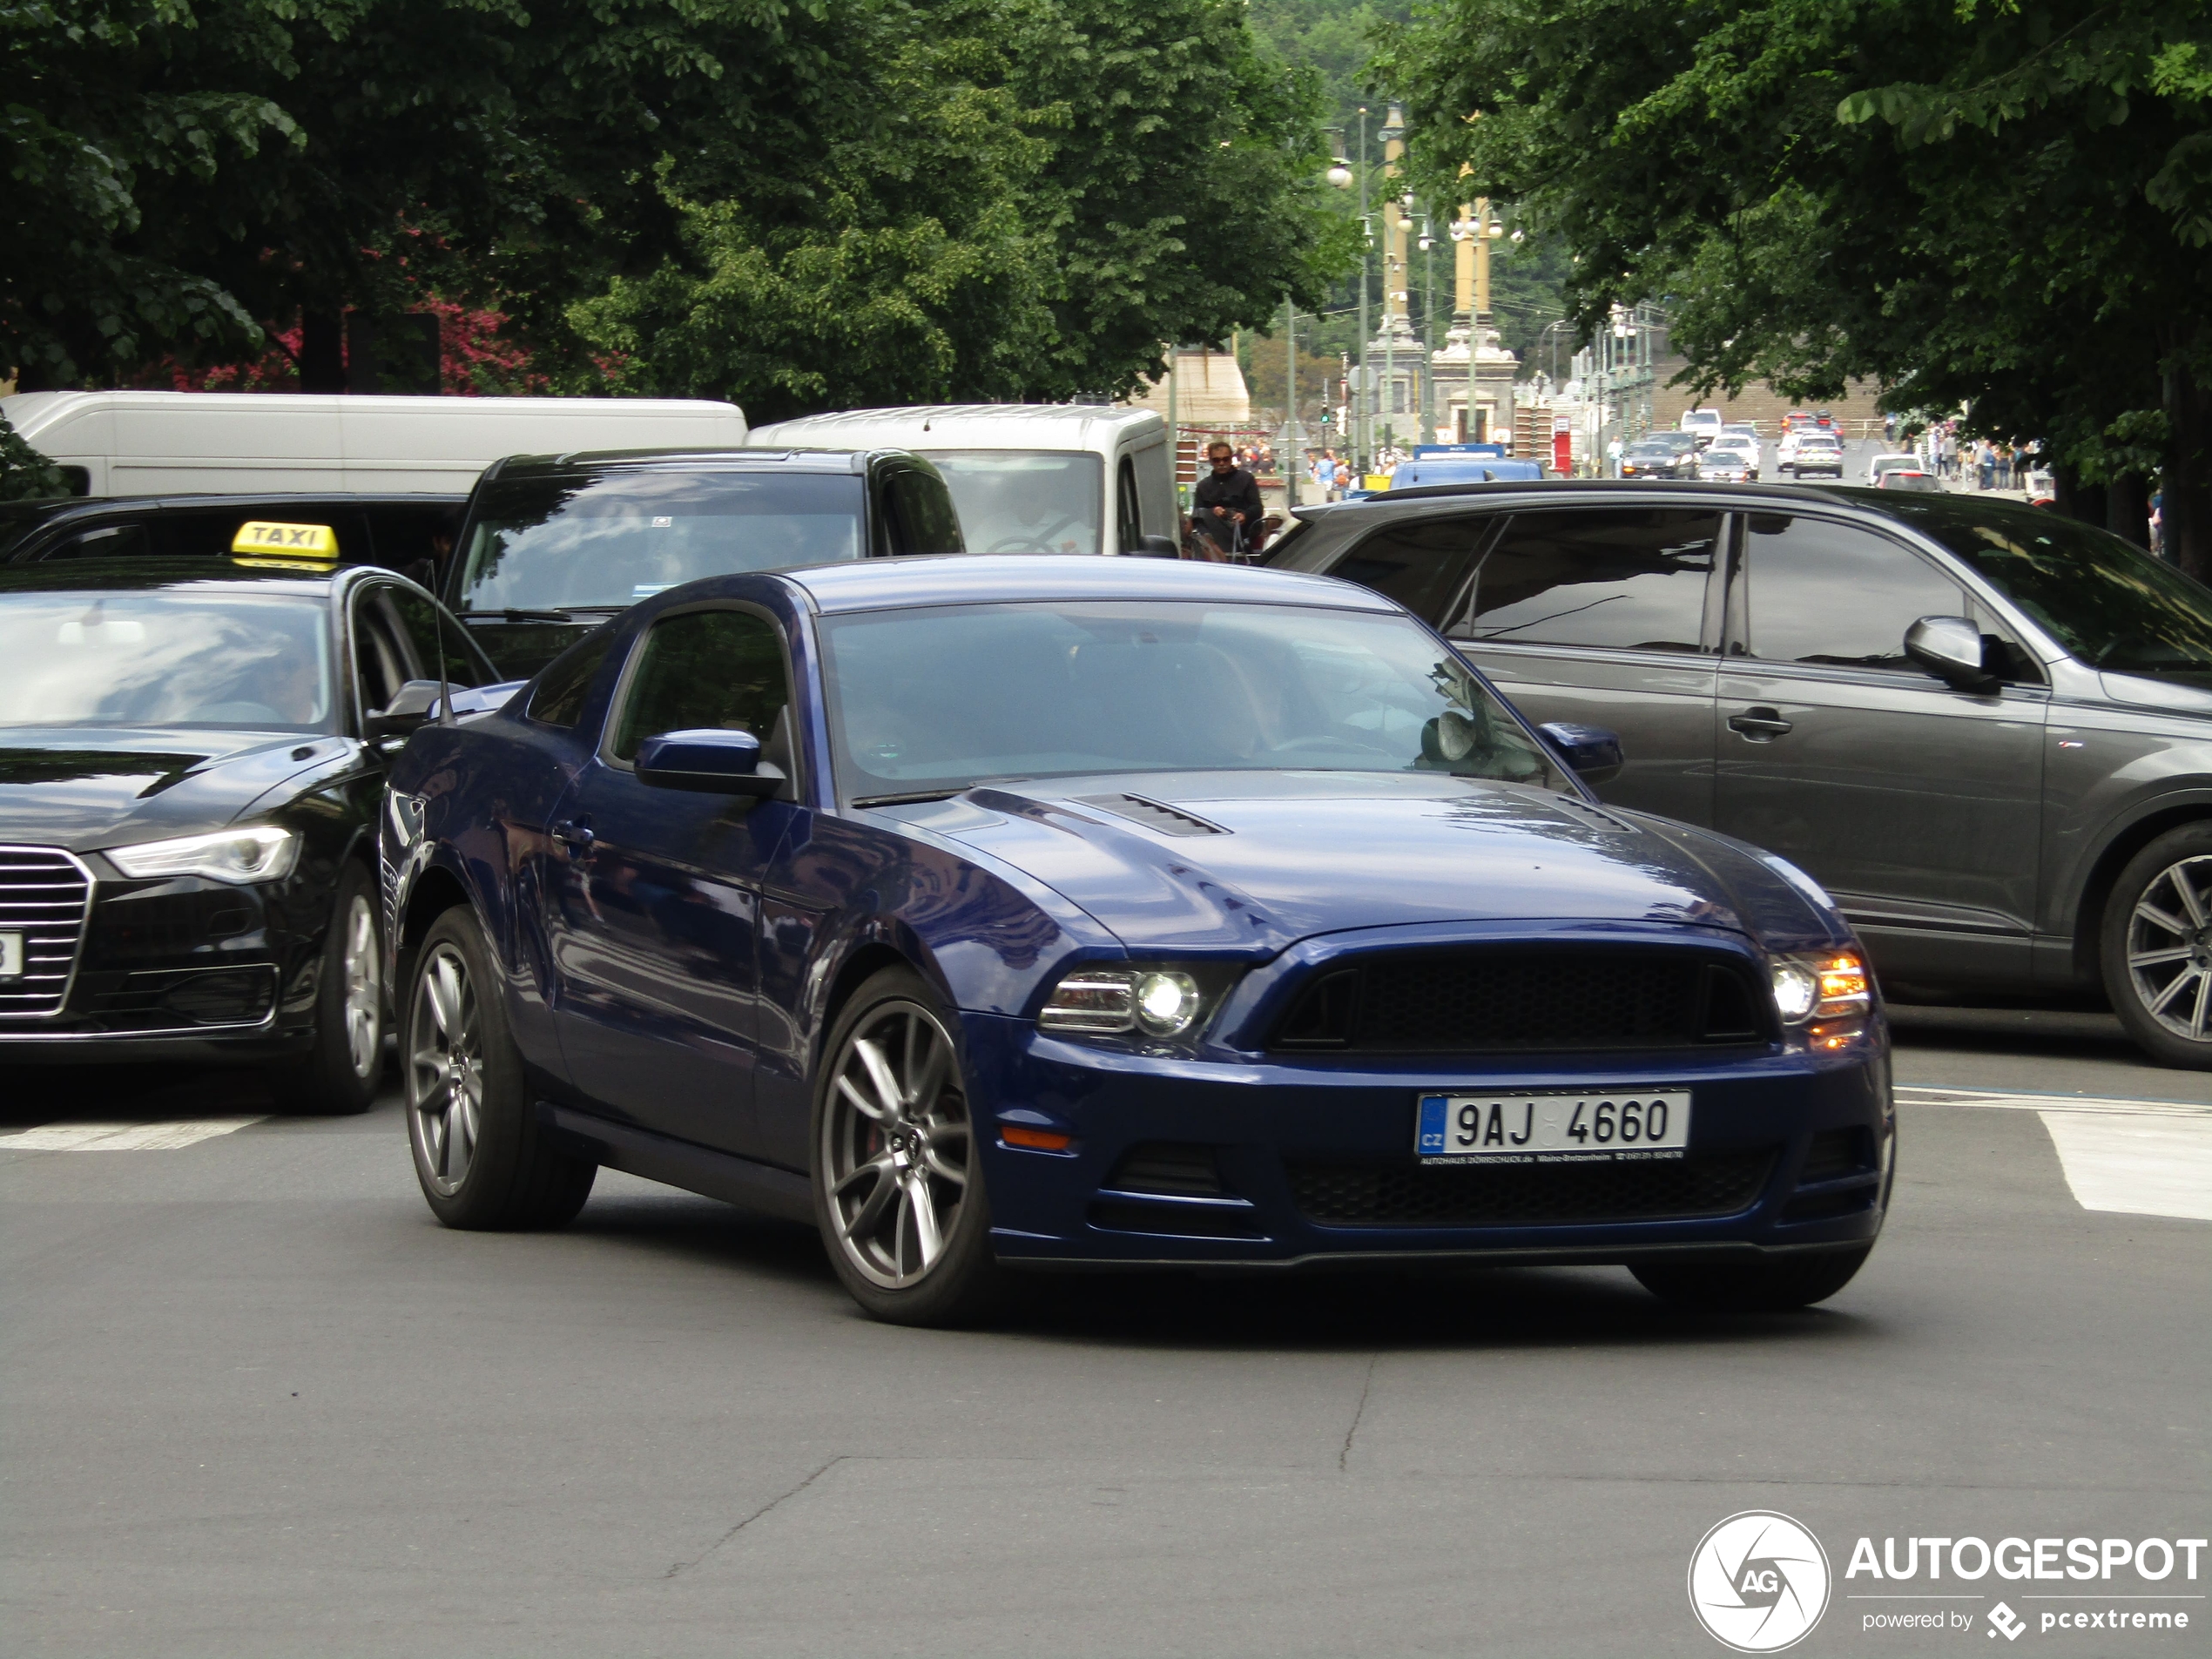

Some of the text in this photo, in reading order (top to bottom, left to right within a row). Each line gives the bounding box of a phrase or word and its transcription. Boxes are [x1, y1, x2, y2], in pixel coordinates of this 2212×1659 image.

[253, 527, 317, 547] TAXI
[1456, 1100, 1669, 1146] 9AJ 4660
[1421, 1133, 1443, 1146] CZ
